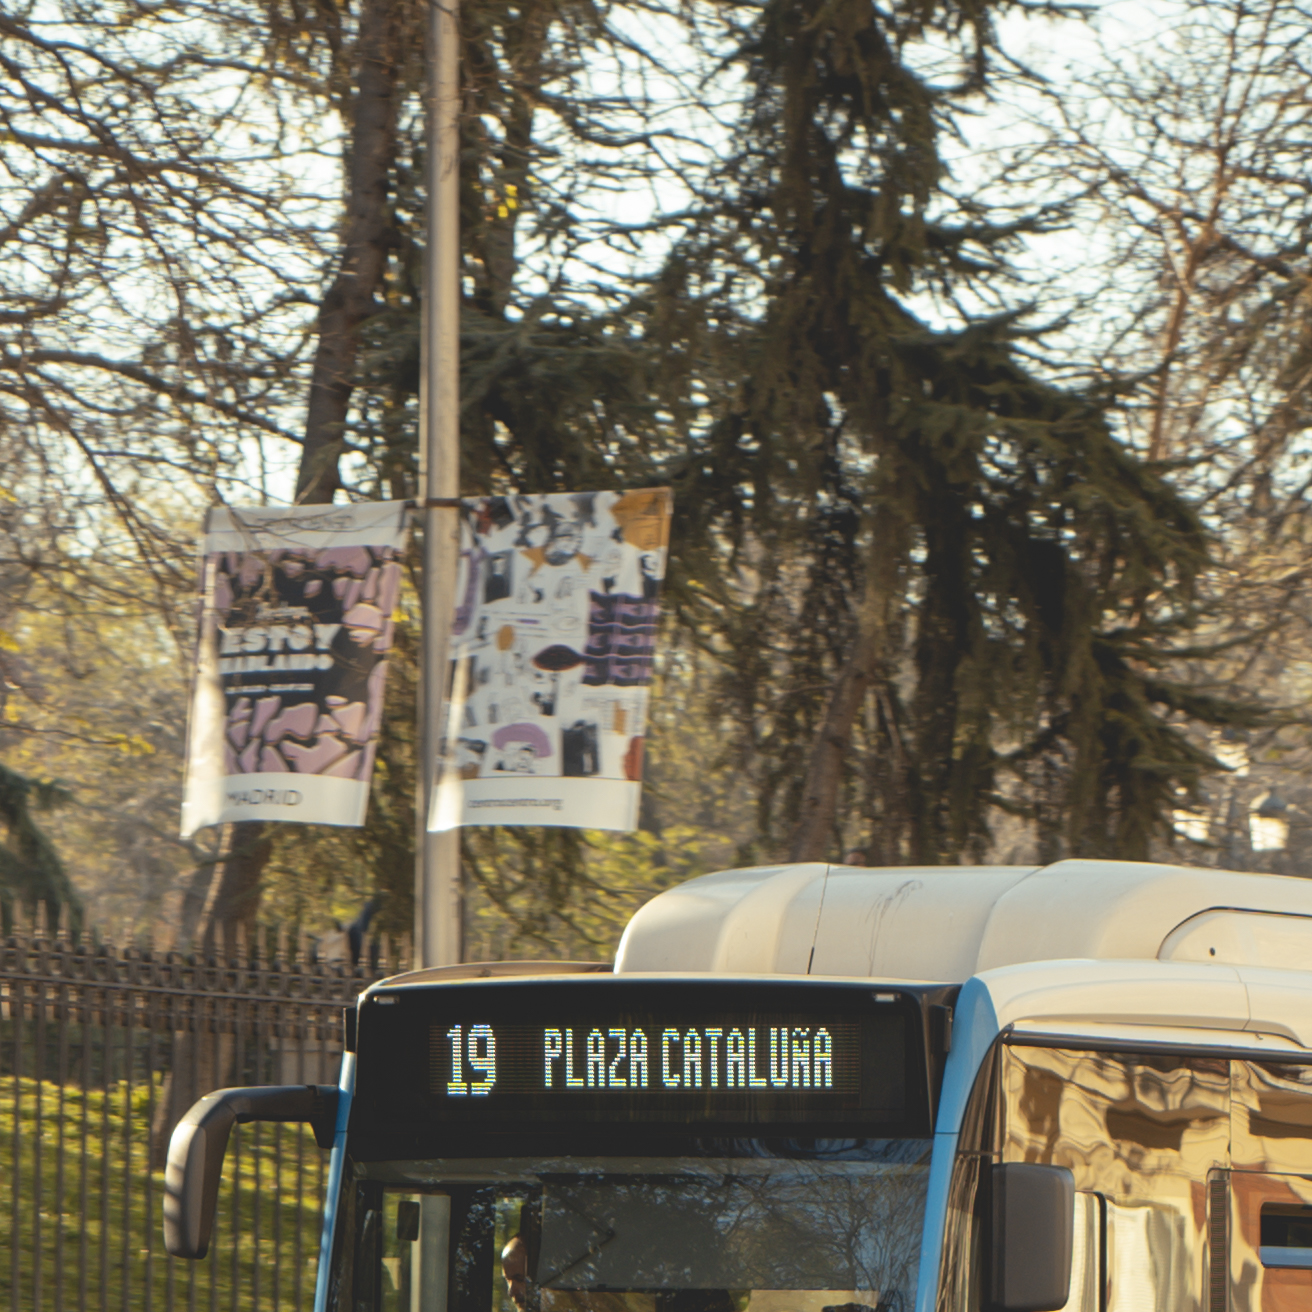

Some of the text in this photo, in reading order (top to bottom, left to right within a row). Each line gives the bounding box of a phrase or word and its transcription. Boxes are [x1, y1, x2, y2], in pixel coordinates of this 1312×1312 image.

[220, 623, 341, 653] ESTOY
[446, 1024, 832, 1095] 19 PLAZA CATALUÑA
